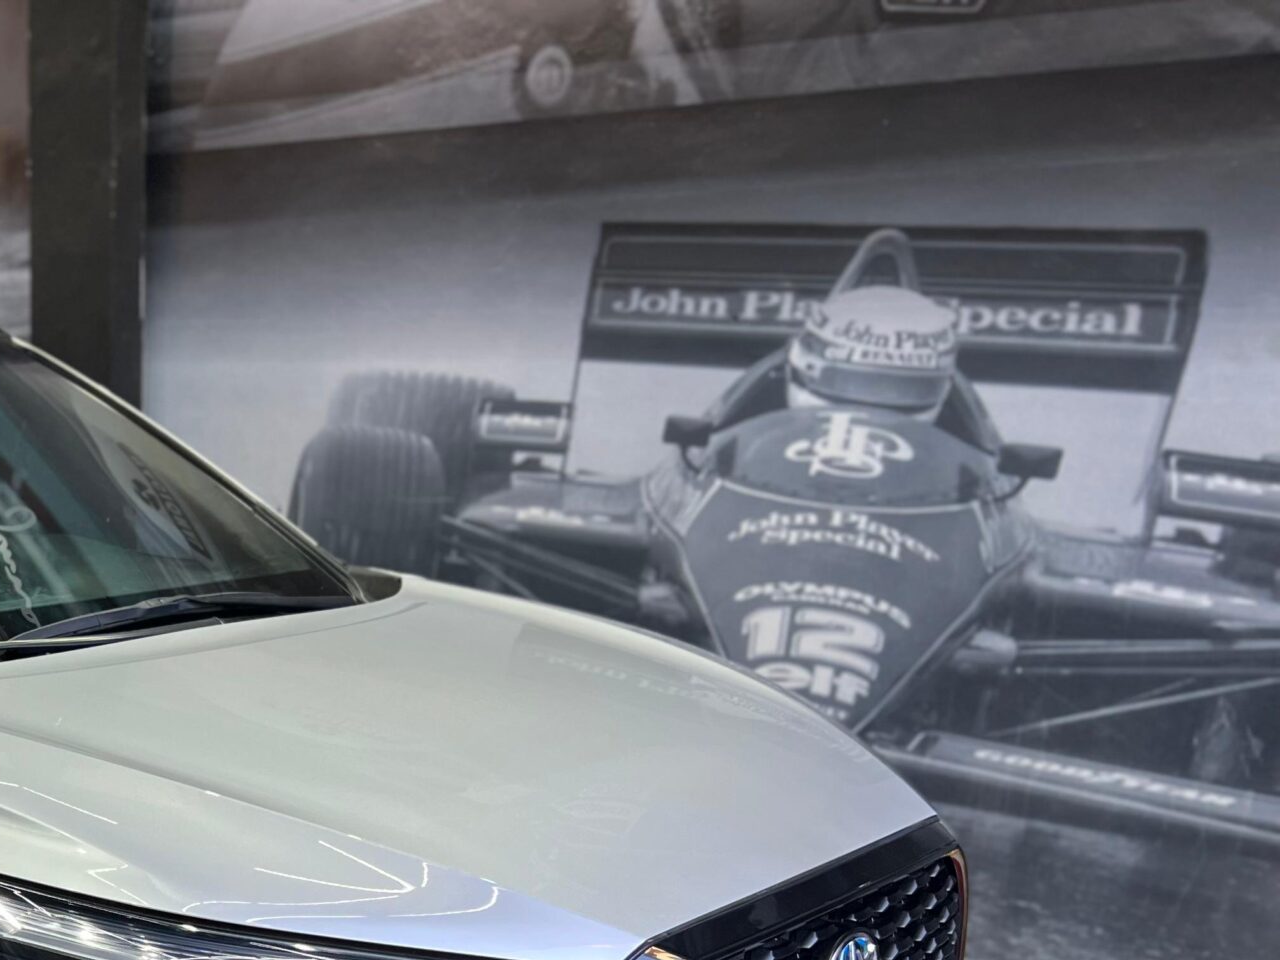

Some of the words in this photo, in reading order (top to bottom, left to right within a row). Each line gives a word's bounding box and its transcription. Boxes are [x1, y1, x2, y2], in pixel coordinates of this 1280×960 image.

[612, 287, 727, 319] John
[734, 290, 826, 324] Pla
[952, 298, 1142, 336] pecial
[833, 319, 889, 348] John
[728, 510, 818, 542] John
[829, 510, 940, 562] Player
[760, 528, 902, 561] Special
[733, 581, 912, 630] OLYMPUS
[740, 605, 886, 681] 12
[753, 661, 871, 706] elf
